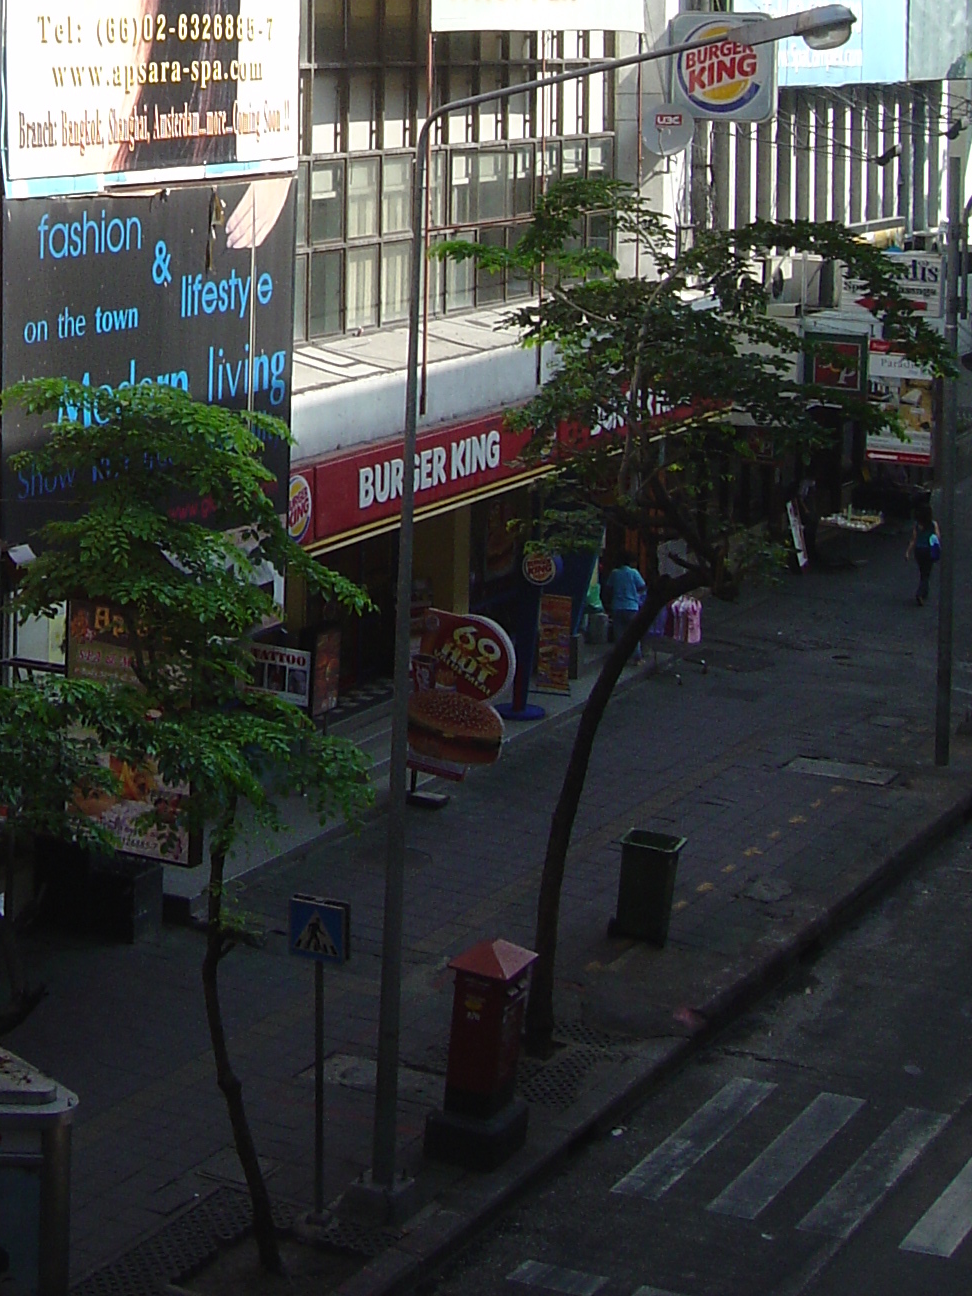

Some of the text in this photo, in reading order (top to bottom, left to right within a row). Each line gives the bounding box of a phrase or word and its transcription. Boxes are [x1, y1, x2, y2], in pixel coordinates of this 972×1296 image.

[37, 14, 81, 44] Tel:
[686, 40, 754, 70] BURGER
[689, 53, 757, 93] KING
[52, 58, 263, 94] www.apsara-spa.com
[19, 110, 58, 149] Branch:
[38, 209, 142, 260] fashion
[152, 239, 172, 285] &
[181, 268, 273, 318] lifestye
[23, 305, 139, 344] on the town
[208, 342, 286, 406] living
[451, 430, 500, 481] KING
[250, 647, 306, 666] TATTOO
[453, 625, 502, 663] 69
